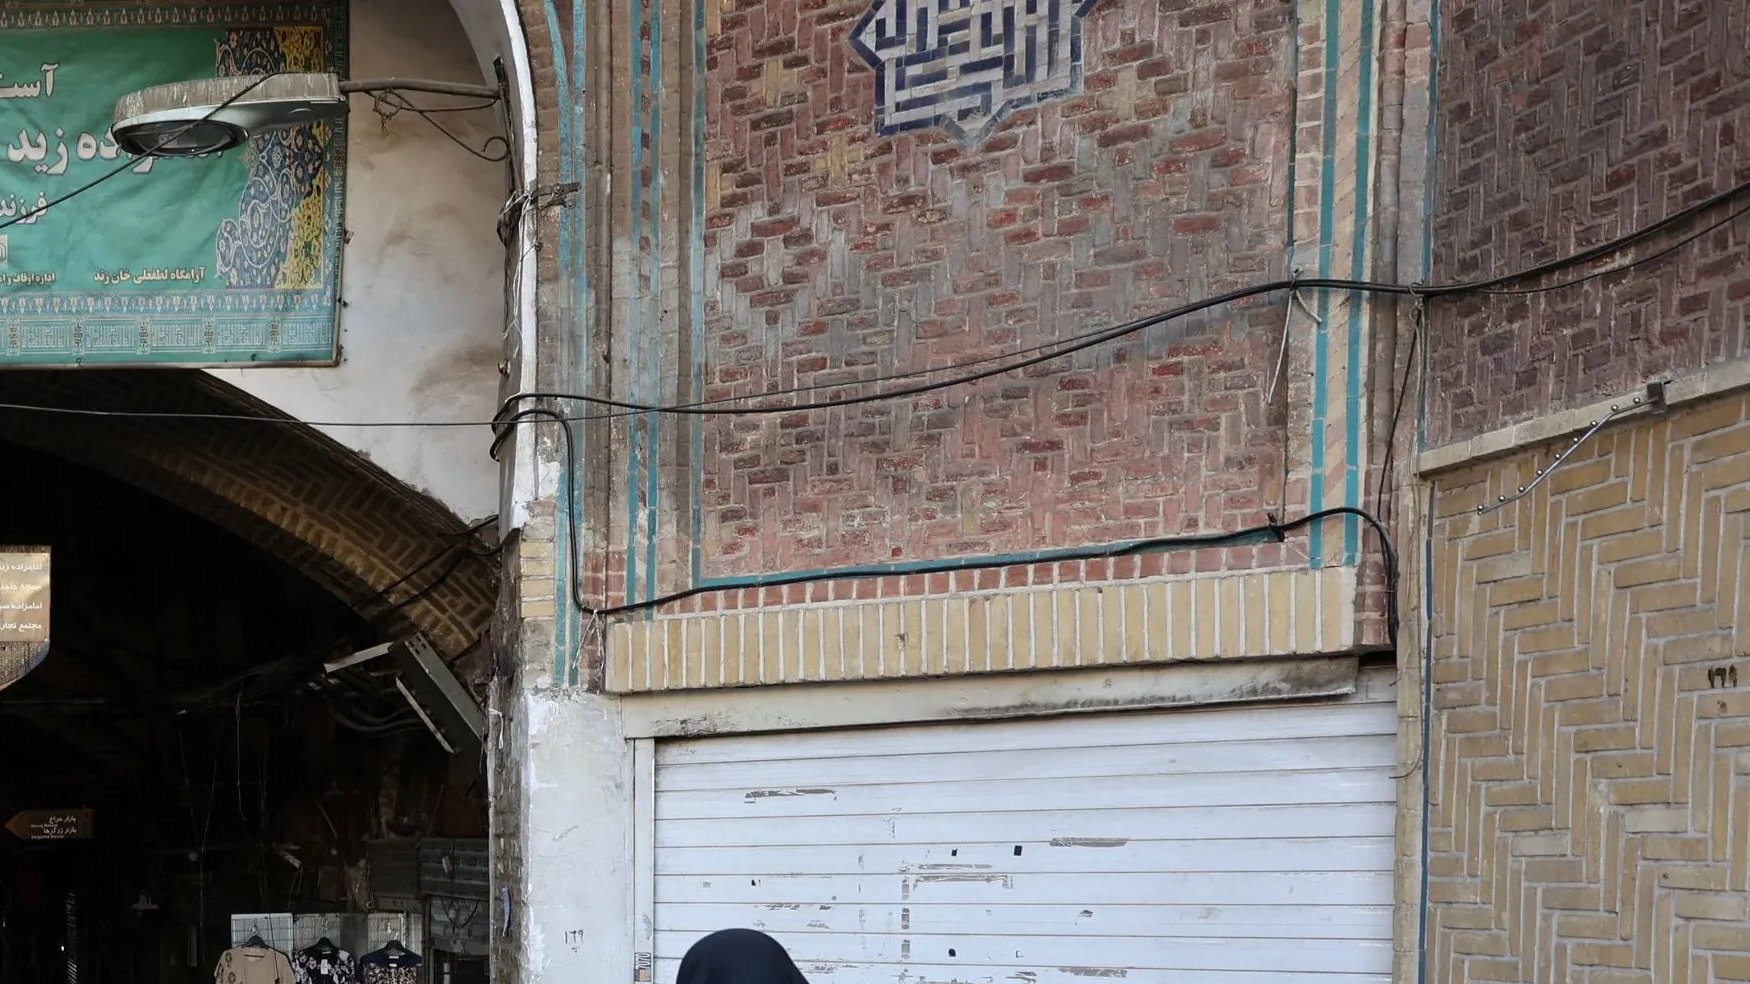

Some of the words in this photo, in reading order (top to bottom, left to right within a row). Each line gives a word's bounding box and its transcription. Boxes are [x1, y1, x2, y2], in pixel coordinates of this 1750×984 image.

[7, 127, 69, 175] زید
[94, 269, 110, 285] زند
[111, 268, 131, 285] خان
[133, 268, 168, 284] لطفعلی
[170, 266, 205, 284] آرامگاه
